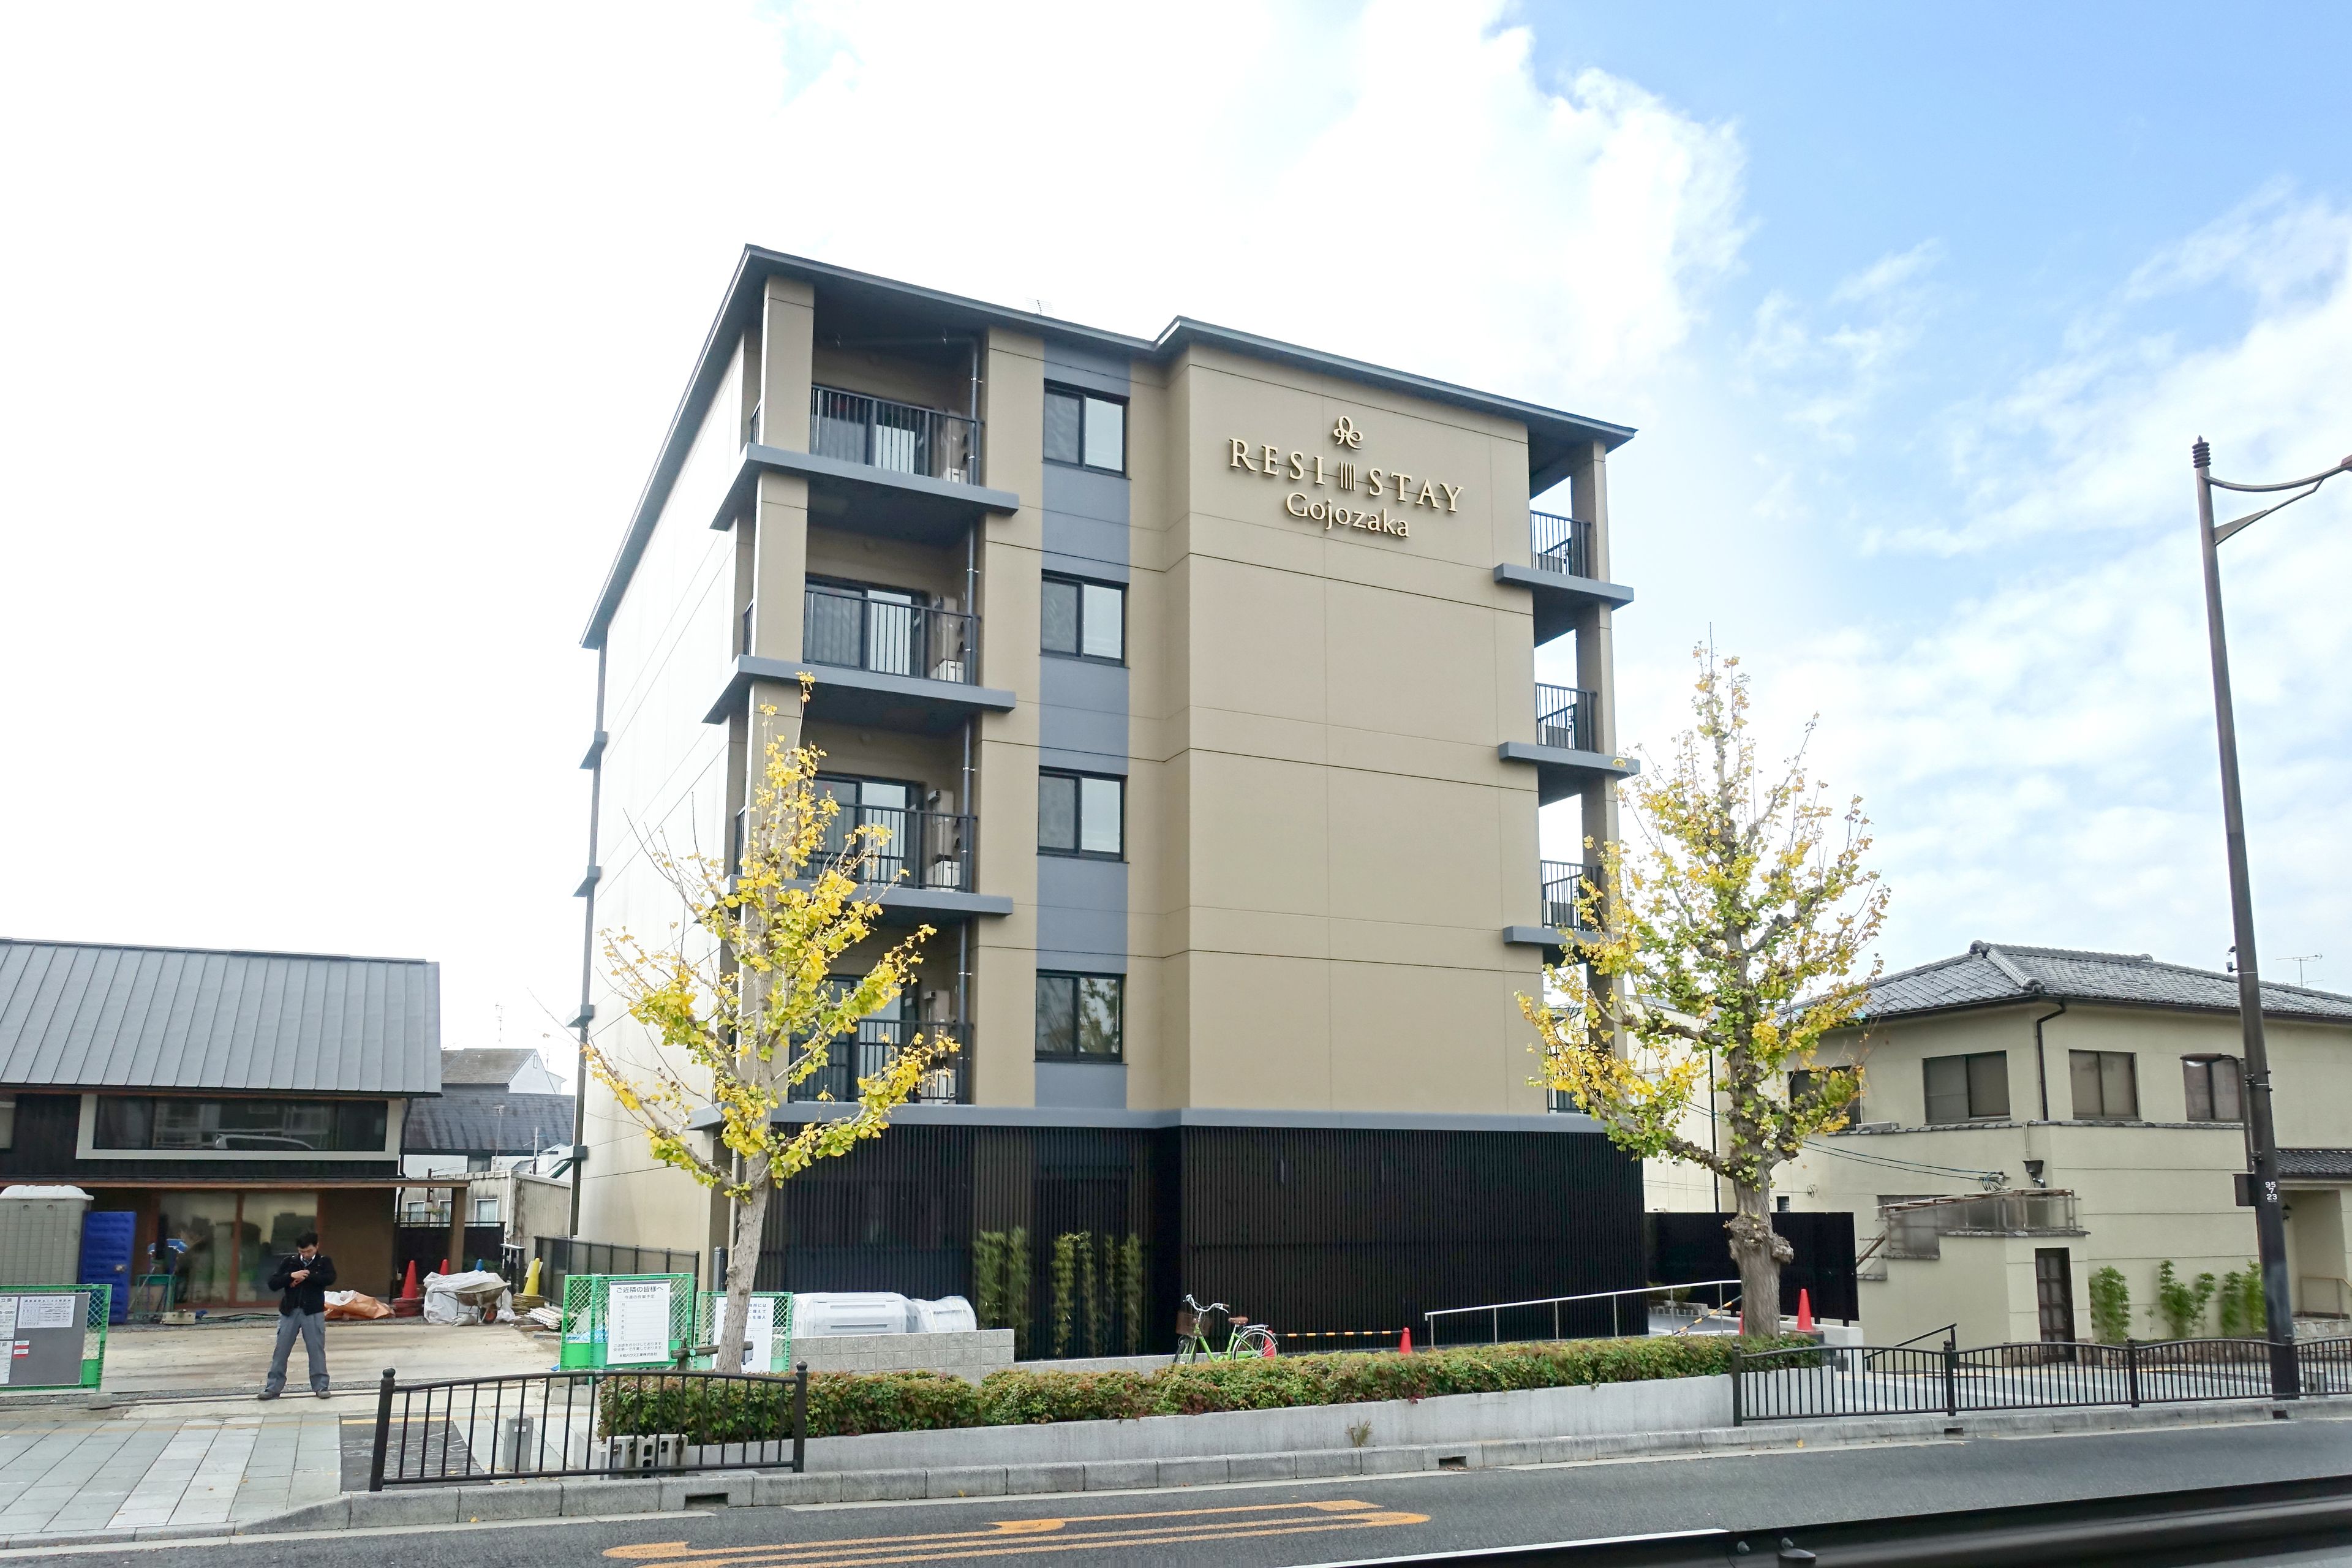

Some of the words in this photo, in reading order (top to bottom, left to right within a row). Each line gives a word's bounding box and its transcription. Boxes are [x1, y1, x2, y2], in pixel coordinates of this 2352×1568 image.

[1229, 438, 1325, 485] RESI
[1369, 467, 1464, 512] STAY
[1286, 492, 1410, 537] Gojozaka
